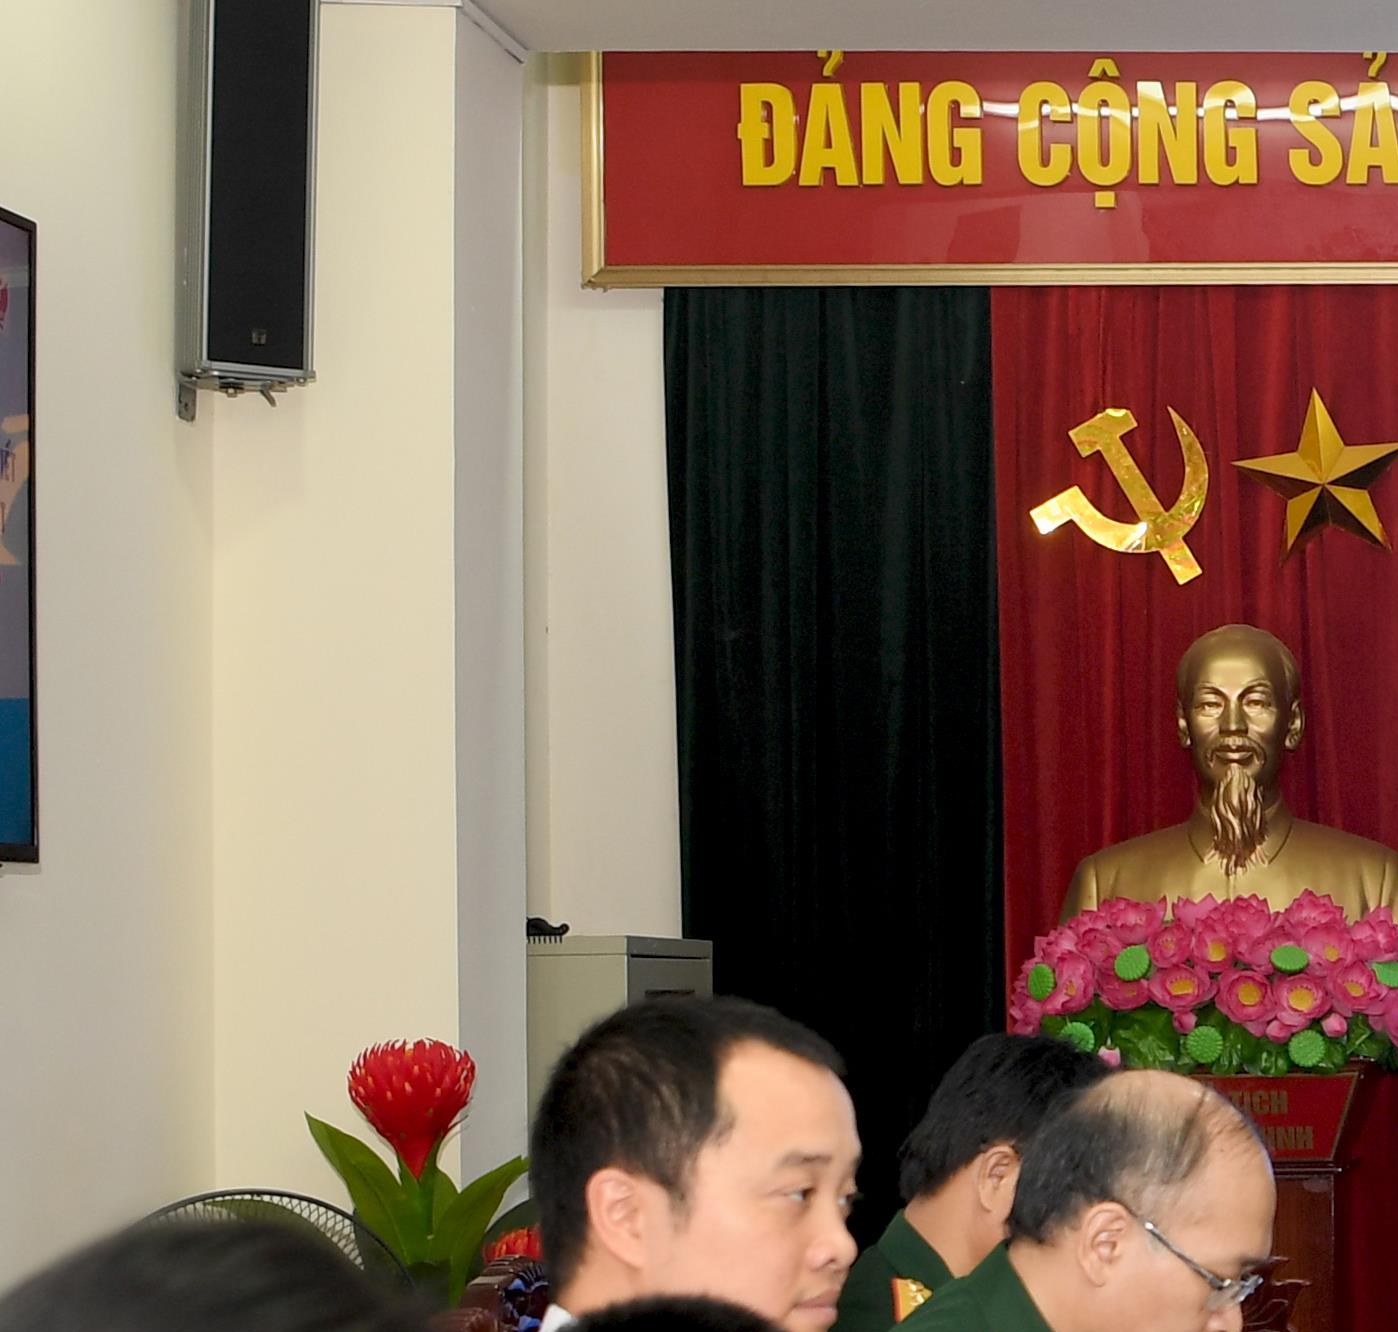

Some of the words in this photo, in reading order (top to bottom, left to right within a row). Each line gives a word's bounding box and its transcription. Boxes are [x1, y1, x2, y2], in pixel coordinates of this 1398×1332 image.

[738, 50, 983, 185] ĐẢNG
[1017, 59, 1258, 207] CỘNG
[1261, 1126, 1313, 1149] INH
